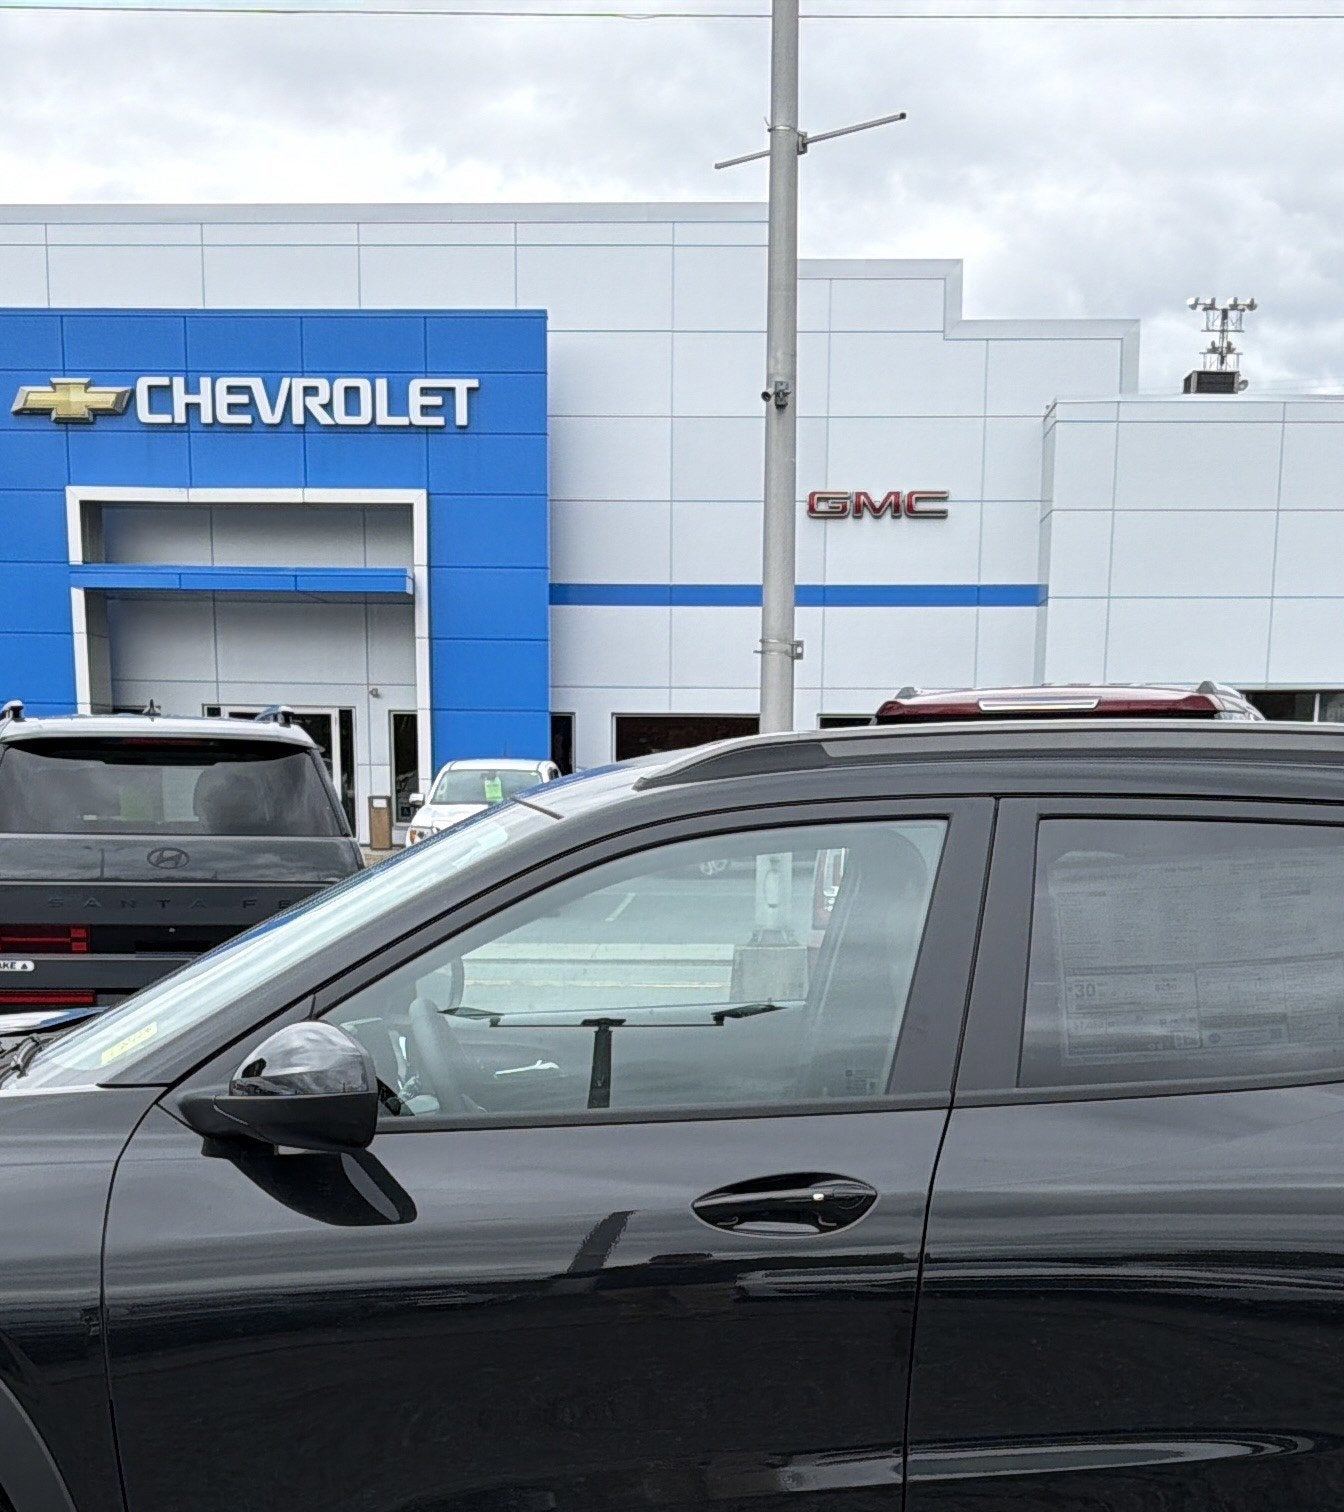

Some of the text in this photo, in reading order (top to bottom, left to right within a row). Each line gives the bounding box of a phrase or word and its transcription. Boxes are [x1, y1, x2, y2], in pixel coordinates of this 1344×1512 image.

[136, 377, 480, 426] CHEVROLET
[808, 491, 948, 518] GMC
[46, 897, 207, 909] SANTA
